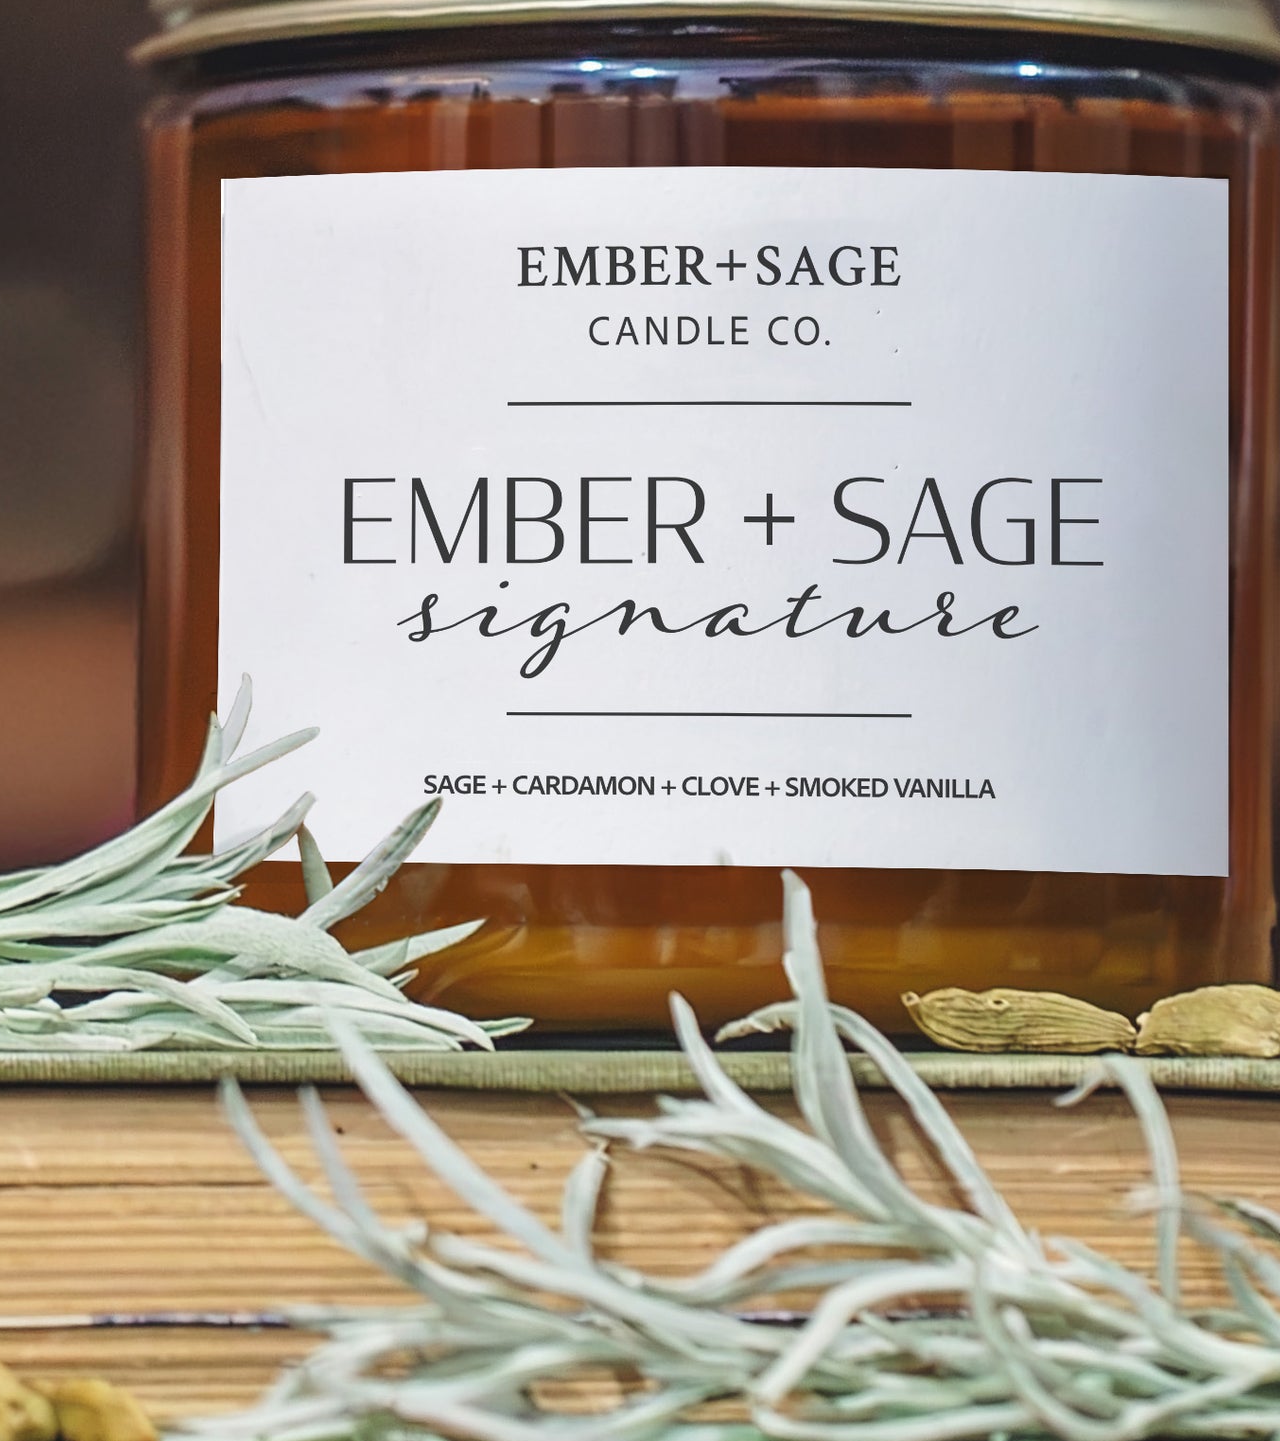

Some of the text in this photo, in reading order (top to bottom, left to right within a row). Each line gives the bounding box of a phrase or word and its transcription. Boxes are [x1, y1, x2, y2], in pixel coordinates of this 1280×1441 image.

[588, 315, 831, 346] CANDLE CO.
[343, 476, 1105, 567] EMBER + SAGE
[396, 580, 1040, 679] signature
[423, 774, 997, 800] SAGE + CARDAMON + CLOVE + SMOKED VANILLA
